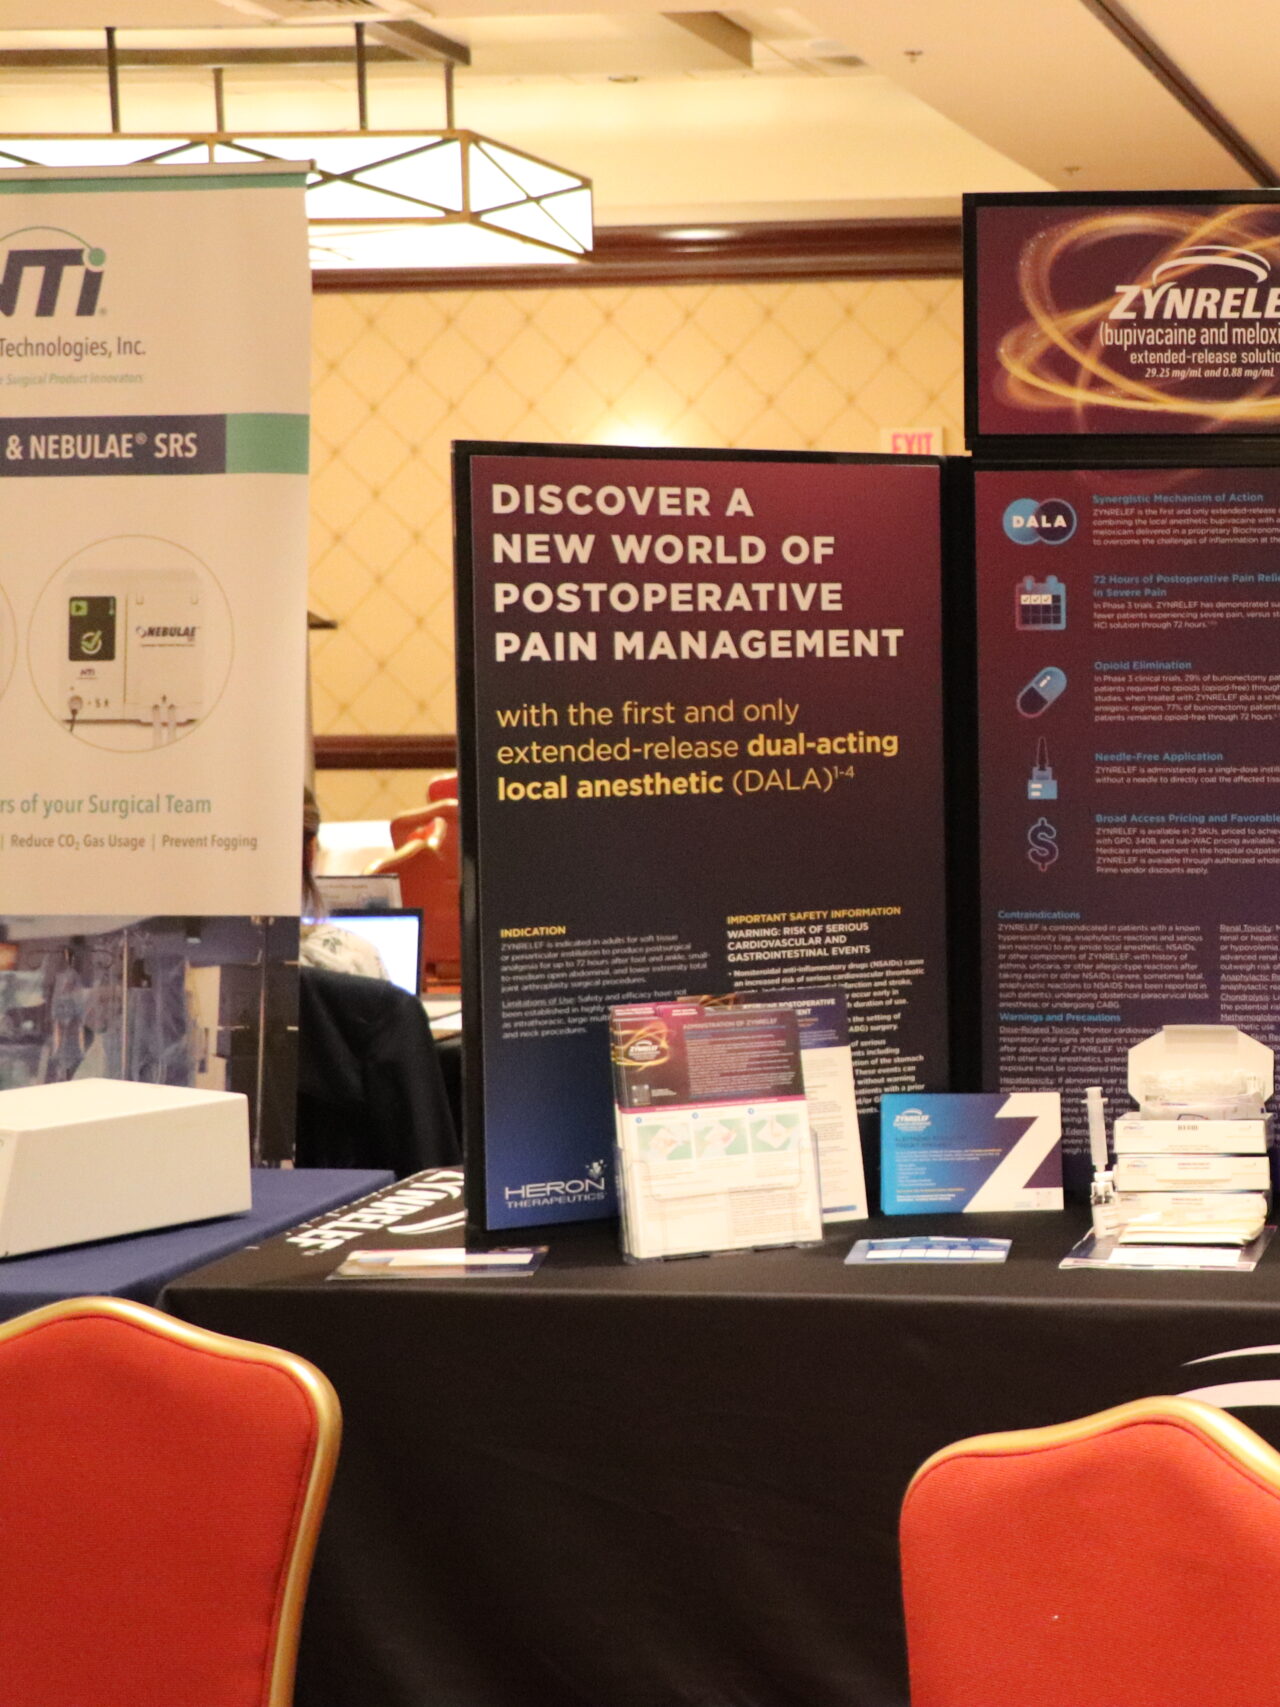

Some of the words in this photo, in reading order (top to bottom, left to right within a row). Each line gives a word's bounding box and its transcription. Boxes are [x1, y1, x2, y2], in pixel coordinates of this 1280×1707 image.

[1100, 322, 1196, 351] (bupivacaine
[1200, 322, 1228, 345] and
[117, 337, 146, 355] Inc.
[1130, 350, 1237, 364] extended-release
[50, 373, 87, 384] Product
[1145, 368, 1170, 378] 29.25
[1172, 368, 1202, 379] mg/mL
[1205, 368, 1221, 377] and
[1223, 368, 1242, 377] 0.88
[1244, 368, 1275, 379] mg/mL
[6, 437, 23, 459] &
[155, 433, 197, 458] SRS
[892, 432, 933, 455] EXIT
[492, 484, 710, 516] DISCOVER
[726, 488, 754, 517] A
[1093, 495, 1149, 504] Synergistic
[1154, 494, 1212, 503] Mechanism
[1230, 494, 1264, 502] Action
[1012, 515, 1067, 528] DALA
[493, 534, 595, 563] NEW
[611, 535, 766, 563] WORLD
[781, 535, 835, 564] OF
[1094, 576, 1103, 584] 72
[1110, 575, 1139, 584] Hours
[1143, 575, 1153, 583] of
[1157, 575, 1229, 584] Postoperative
[1232, 574, 1254, 582] Pain
[494, 582, 843, 613] POSTOPERATIVE
[1107, 589, 1141, 597] Severe
[1145, 588, 1167, 597] Pain
[495, 631, 597, 662] PAIN
[614, 629, 903, 661] MANAGEMENT
[1094, 661, 1129, 670] Opioid
[1133, 661, 1192, 670] Elimination
[497, 703, 558, 727] with
[568, 702, 613, 726] the
[623, 701, 676, 724] first
[685, 700, 733, 723] and
[744, 698, 799, 725] only
[498, 737, 739, 764] extended-release
[747, 732, 898, 758] dual-acting
[1095, 753, 1159, 761] Needle-Free
[1163, 753, 1223, 762] Application
[498, 776, 567, 800] local
[577, 772, 723, 798] anesthetic
[21, 794, 40, 815] of
[43, 800, 83, 818] your
[88, 794, 159, 819] Surgical
[166, 794, 212, 814] Team
[1096, 815, 1126, 823] Broad
[1130, 815, 1165, 823] Access
[1169, 814, 1205, 824] Pricing
[1208, 814, 1227, 822] and
[11, 834, 54, 848] Reduce
[83, 835, 105, 848] Gas
[108, 835, 145, 852] Usage
[162, 835, 208, 848] Prevent
[211, 835, 257, 852] Fogging
[727, 915, 787, 925] IMPORTANT
[790, 911, 828, 921] SAFETY
[832, 907, 901, 919] INFORMATION
[998, 911, 1080, 919] Contraindications
[501, 926, 566, 938] INDICATION
[727, 928, 781, 938] WARNING:
[784, 925, 806, 935] RISK
[809, 925, 823, 934] OF
[826, 922, 869, 932] SERIOUS
[728, 937, 822, 950] CARDIOVASCULAR
[825, 936, 847, 944] AND
[728, 946, 829, 962] GASTROINTESTINAL
[832, 945, 870, 956] EVENTS
[1000, 1014, 1043, 1022] Warnings
[1066, 1014, 1120, 1022] Precautions
[505, 1178, 605, 1201] HERON
[506, 1192, 604, 1209] THERAPEUTICS
